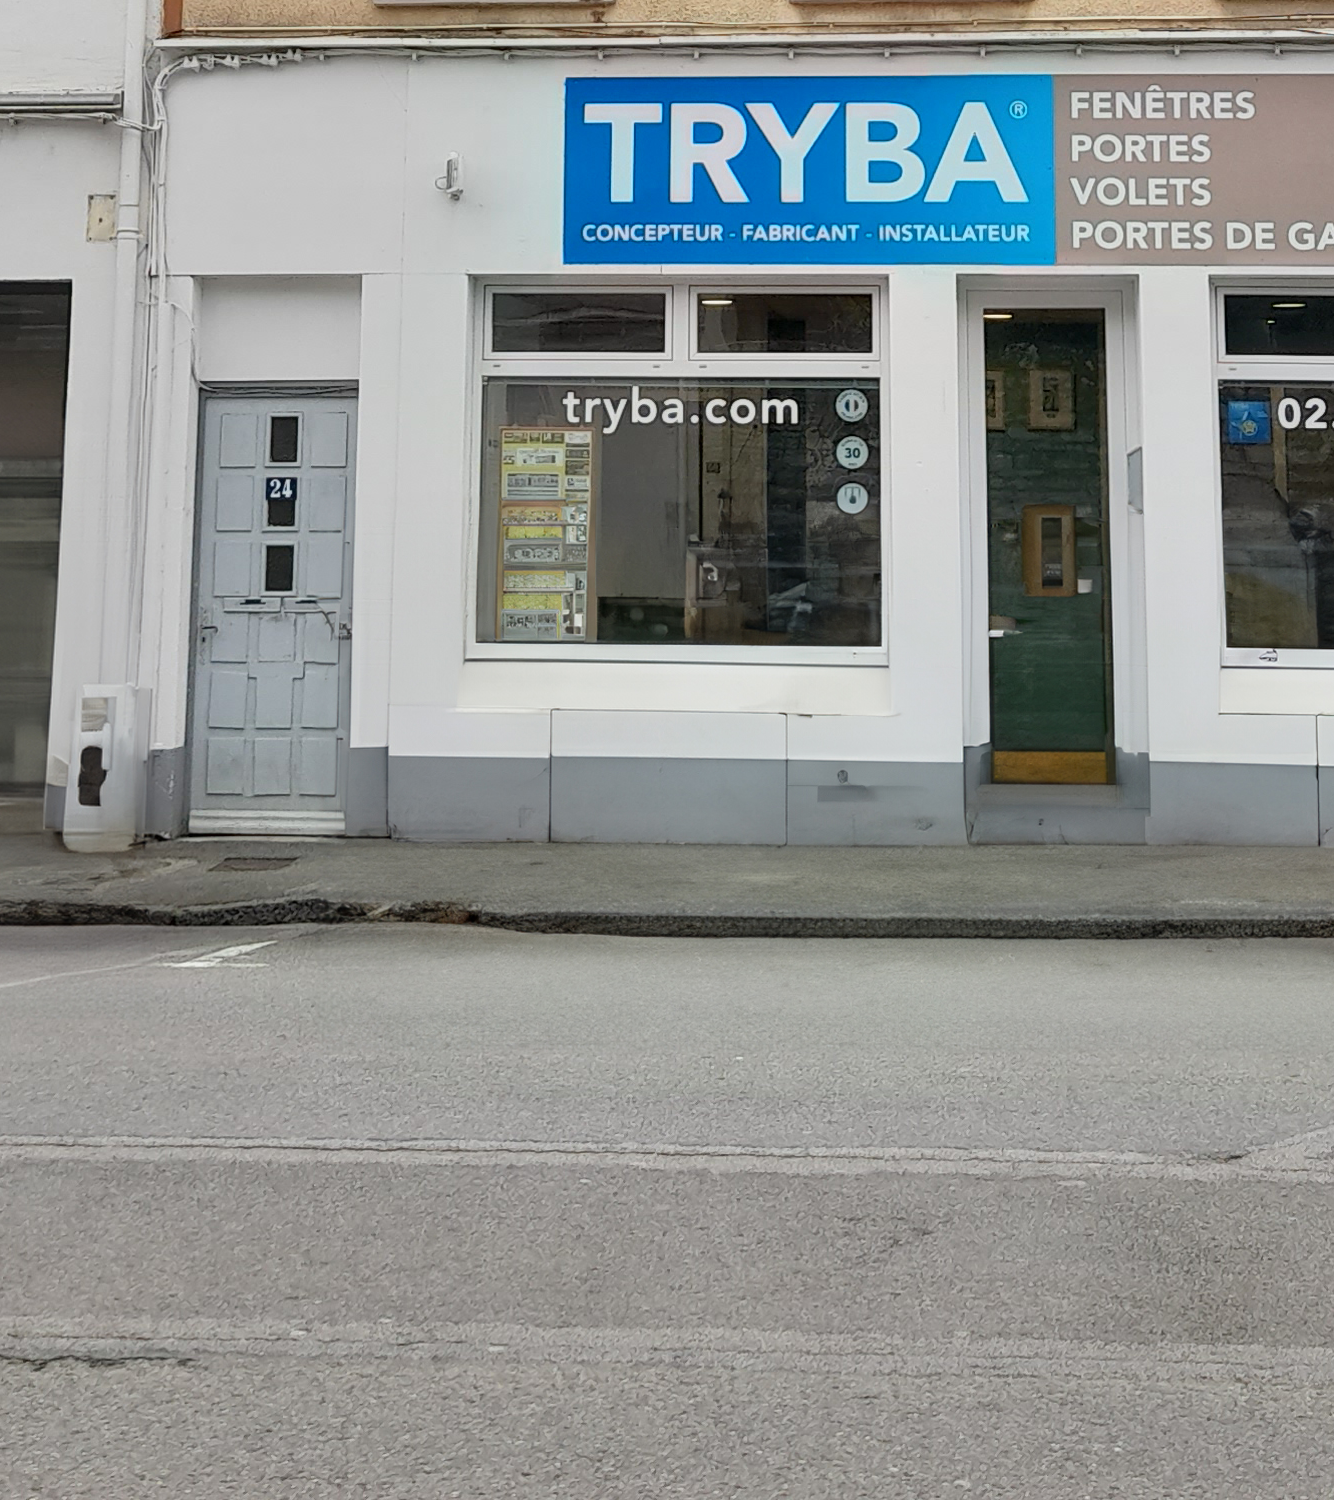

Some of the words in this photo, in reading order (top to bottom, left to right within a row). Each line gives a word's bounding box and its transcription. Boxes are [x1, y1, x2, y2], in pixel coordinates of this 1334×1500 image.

[1069, 85, 1256, 120] FENÊTRES
[1070, 134, 1212, 163] PORTES
[1069, 177, 1212, 206] VOLETS
[582, 224, 724, 242] CONCEPTEUR
[741, 224, 860, 242] FABRICANT
[878, 224, 1031, 242] INSTALLATEUR
[1071, 221, 1213, 250] PORTES
[1226, 222, 1276, 250] DE
[562, 385, 799, 434] tryba.com
[844, 447, 861, 459] 30
[269, 478, 293, 498] 24
